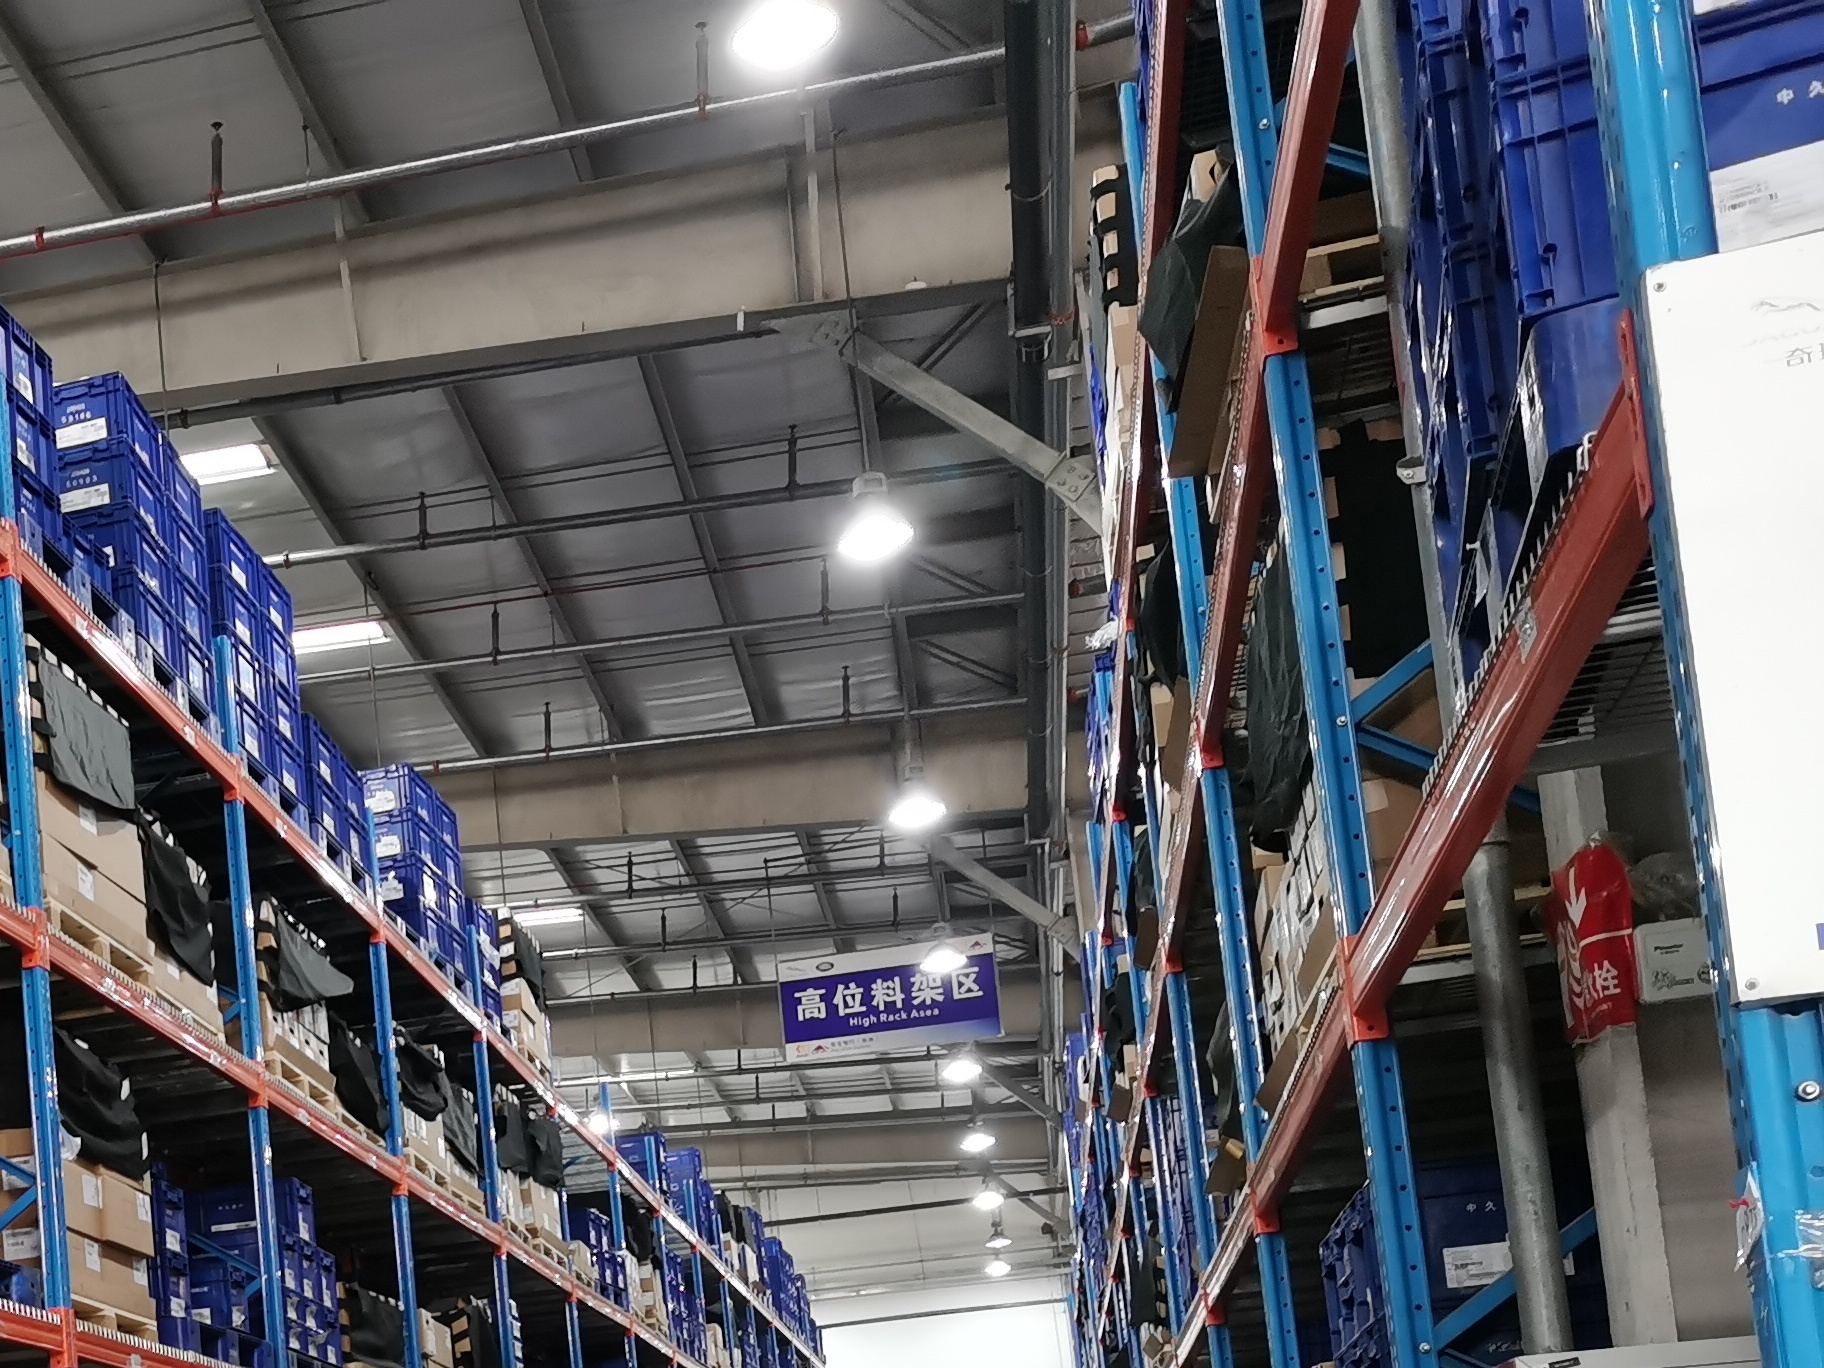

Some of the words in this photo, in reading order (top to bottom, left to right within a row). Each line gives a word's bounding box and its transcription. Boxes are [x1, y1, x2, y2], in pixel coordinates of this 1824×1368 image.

[793, 965, 984, 1022] 高位料架区
[849, 1013, 878, 1028] High
[880, 1010, 909, 1023] Rack
